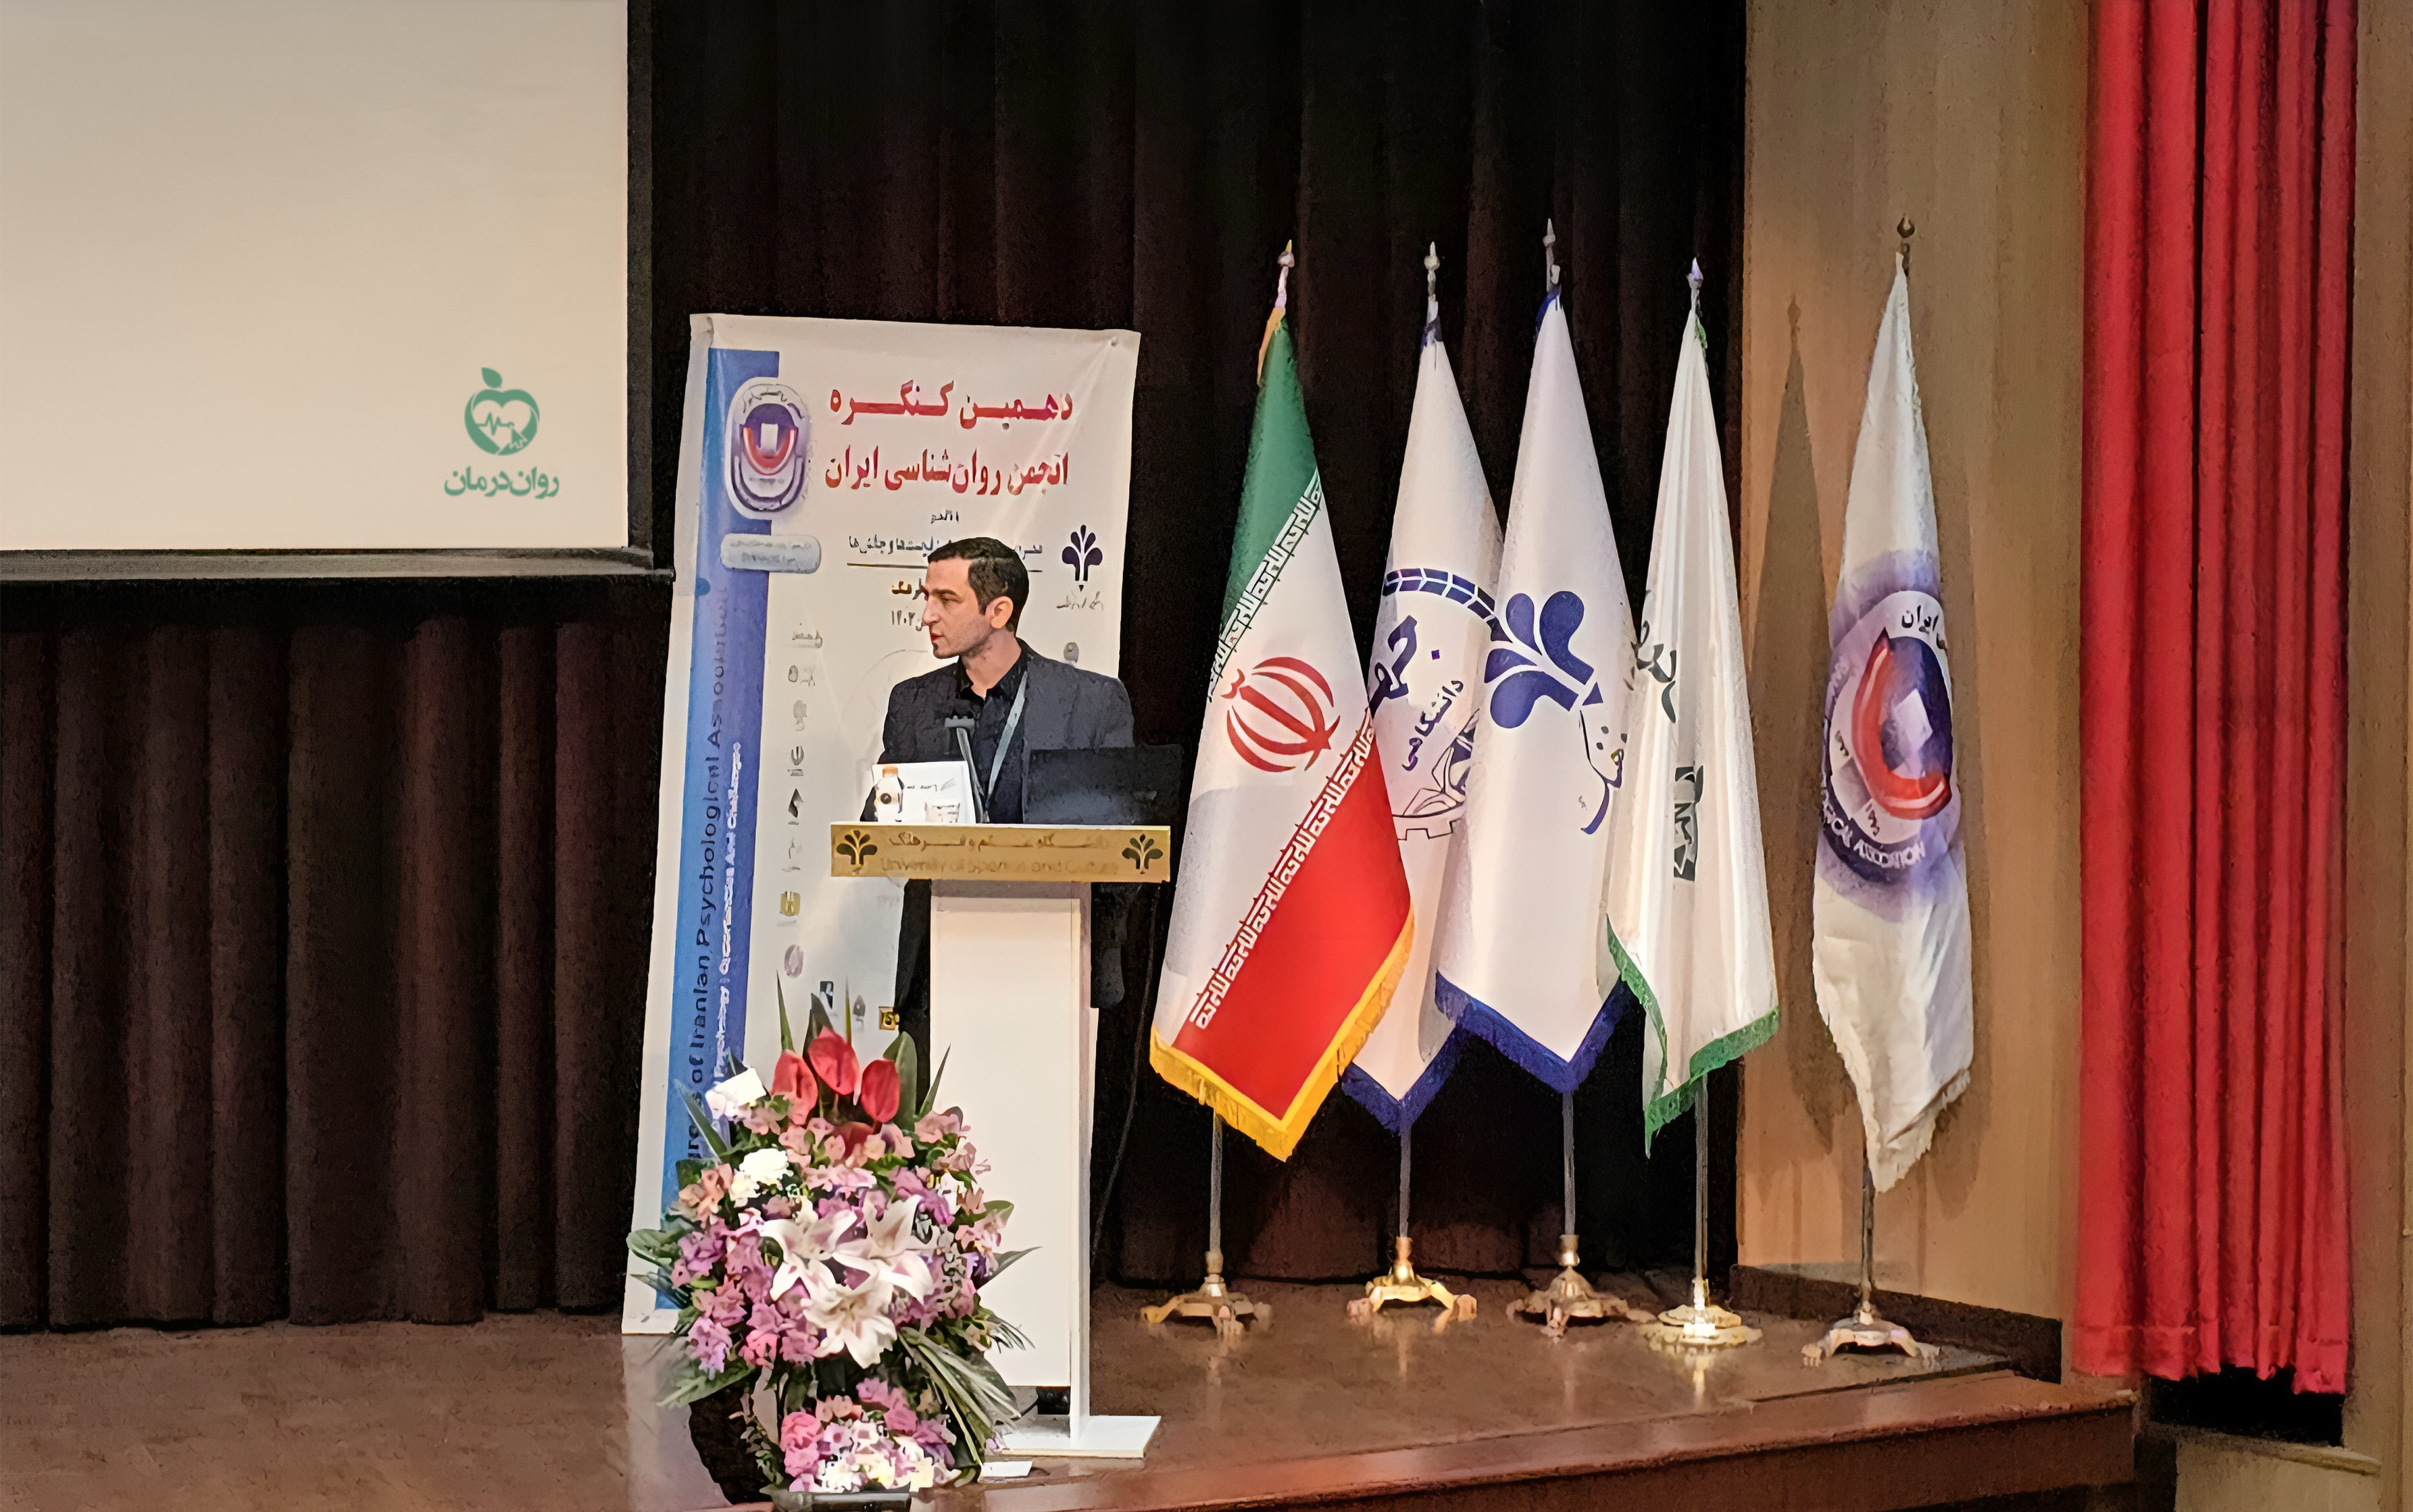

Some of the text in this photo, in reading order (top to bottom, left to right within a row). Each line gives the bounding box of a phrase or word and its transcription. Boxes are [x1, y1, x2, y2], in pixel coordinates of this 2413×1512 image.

[830, 380, 954, 426] کنگره
[960, 393, 1073, 430] دهمین
[825, 444, 878, 489] ایران
[1008, 451, 1069, 496] انجمن
[1901, 605, 1939, 634] ایران
[689, 955, 710, 1049] Iranian
